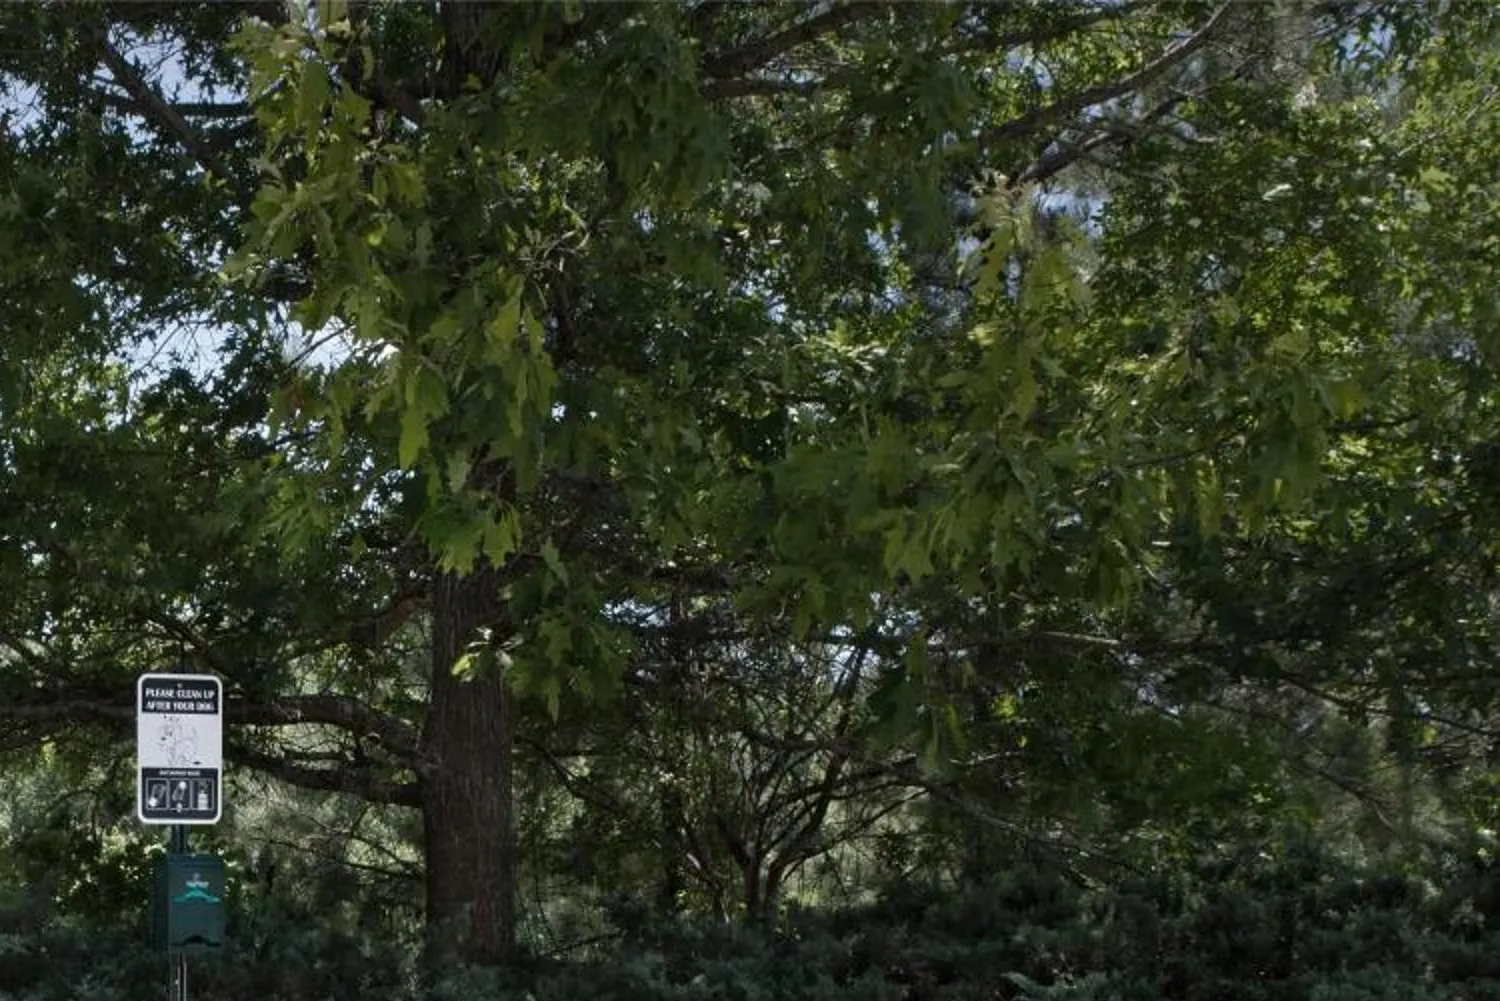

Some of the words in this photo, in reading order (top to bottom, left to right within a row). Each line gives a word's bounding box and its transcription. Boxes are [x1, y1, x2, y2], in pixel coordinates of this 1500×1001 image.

[146, 688, 175, 698] PLEASE
[176, 689, 202, 699] CLEAN
[204, 689, 215, 699] UP
[147, 701, 171, 710] AFTER
[173, 701, 195, 711] YOUR
